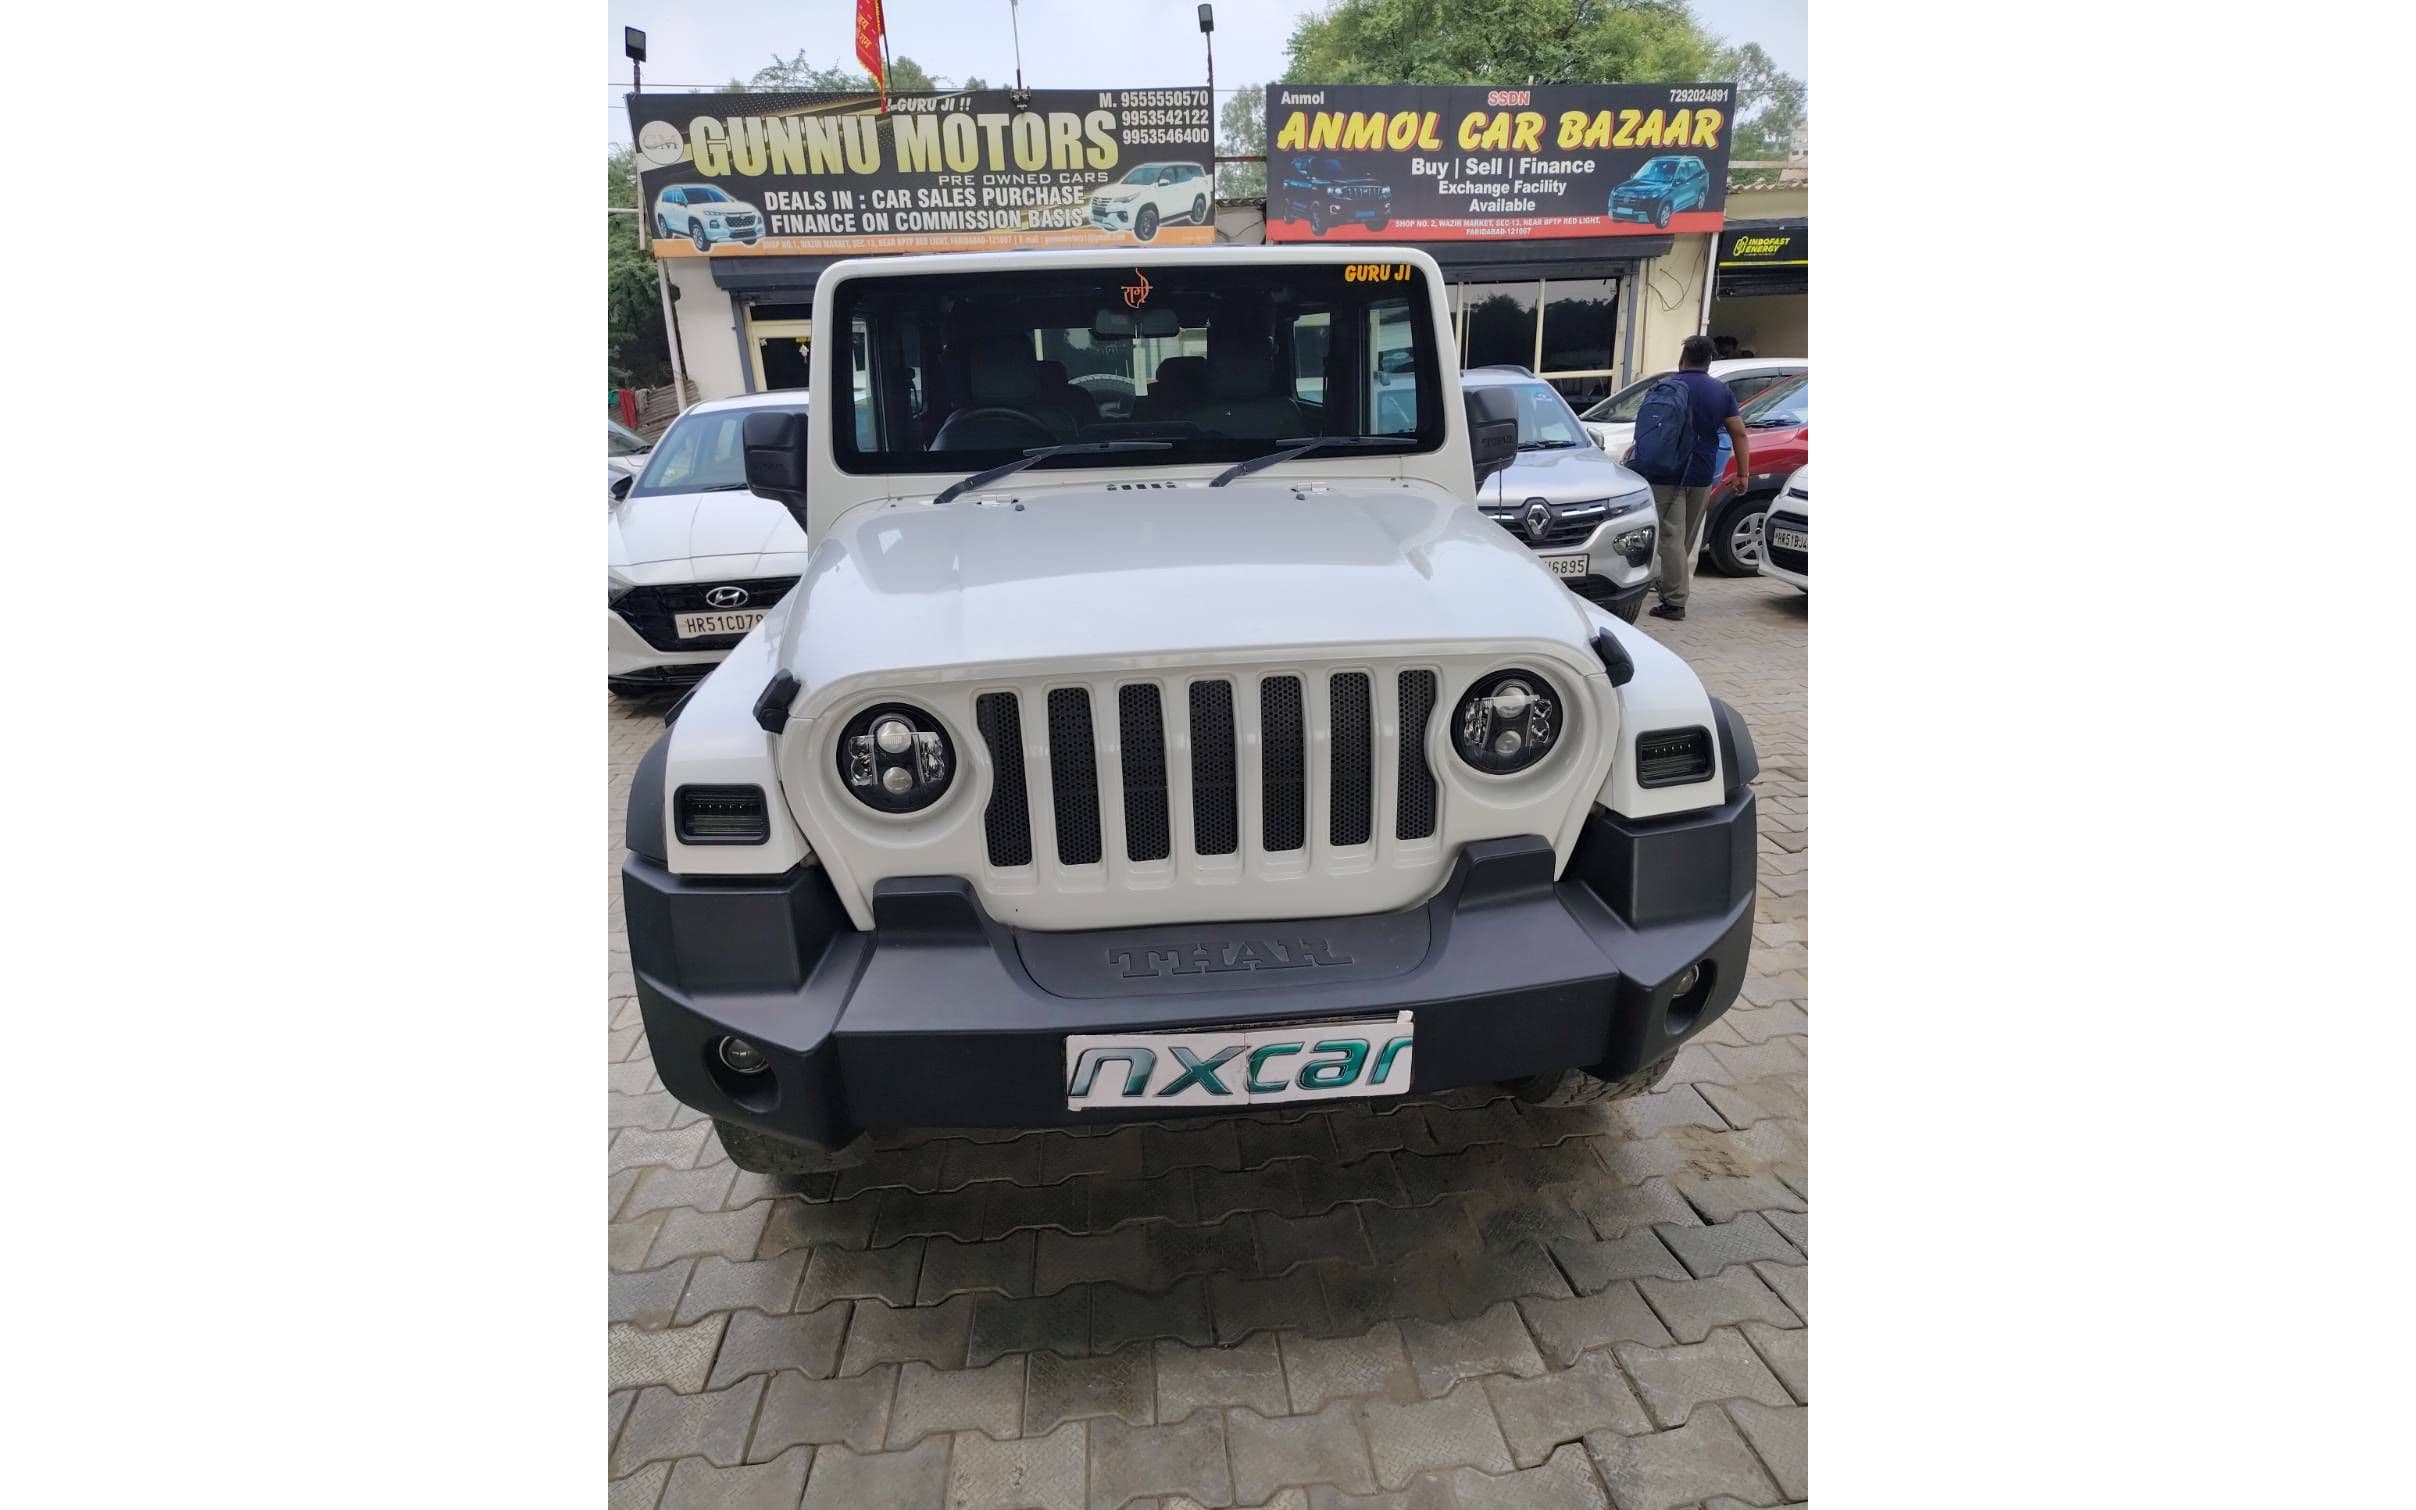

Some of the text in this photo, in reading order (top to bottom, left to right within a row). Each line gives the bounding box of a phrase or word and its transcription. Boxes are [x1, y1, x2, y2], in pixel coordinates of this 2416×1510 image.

[1099, 91, 1209, 108] M. 9555550570
[1281, 91, 1324, 105] Anmol
[1488, 91, 1530, 106] SSDN
[1670, 89, 1728, 103] 7292024891
[897, 98, 937, 112] GURU
[941, 98, 955, 112] JI
[1122, 109, 1209, 126] 9953542122
[1123, 128, 1209, 144] 9953546400
[1276, 107, 1724, 153] ANMOL CAR BAZAAR
[689, 110, 1119, 177] GUNNU MOTORS
[1411, 157, 1449, 179] Buy
[1465, 157, 1502, 176] Sell
[1519, 157, 1596, 174] Finance
[939, 172, 1108, 186] PRE OWNED CARS
[1439, 180, 1567, 197] Exchange Facility
[764, 191, 827, 211] DEALS
[832, 190, 853, 210] IN
[872, 189, 912, 209] CAR
[917, 187, 976, 208] SALES
[983, 186, 1085, 206] PURCHASE
[1469, 198, 1536, 212] Available
[771, 207, 1083, 233] FINANCE ON COMMISSION BASIS
[1395, 220, 1415, 228] SHOP
[1439, 219, 1462, 227] WAZIR
[1563, 216, 1577, 225] RED
[1745, 245, 1780, 253] ENERGY
[1749, 237, 1791, 245] INDOFAST
[1345, 263, 1411, 282] GURU JI
[1544, 560, 1585, 574] 6895
[1108, 936, 1353, 978] THAR
[1067, 1036, 1413, 1098] nxcar
